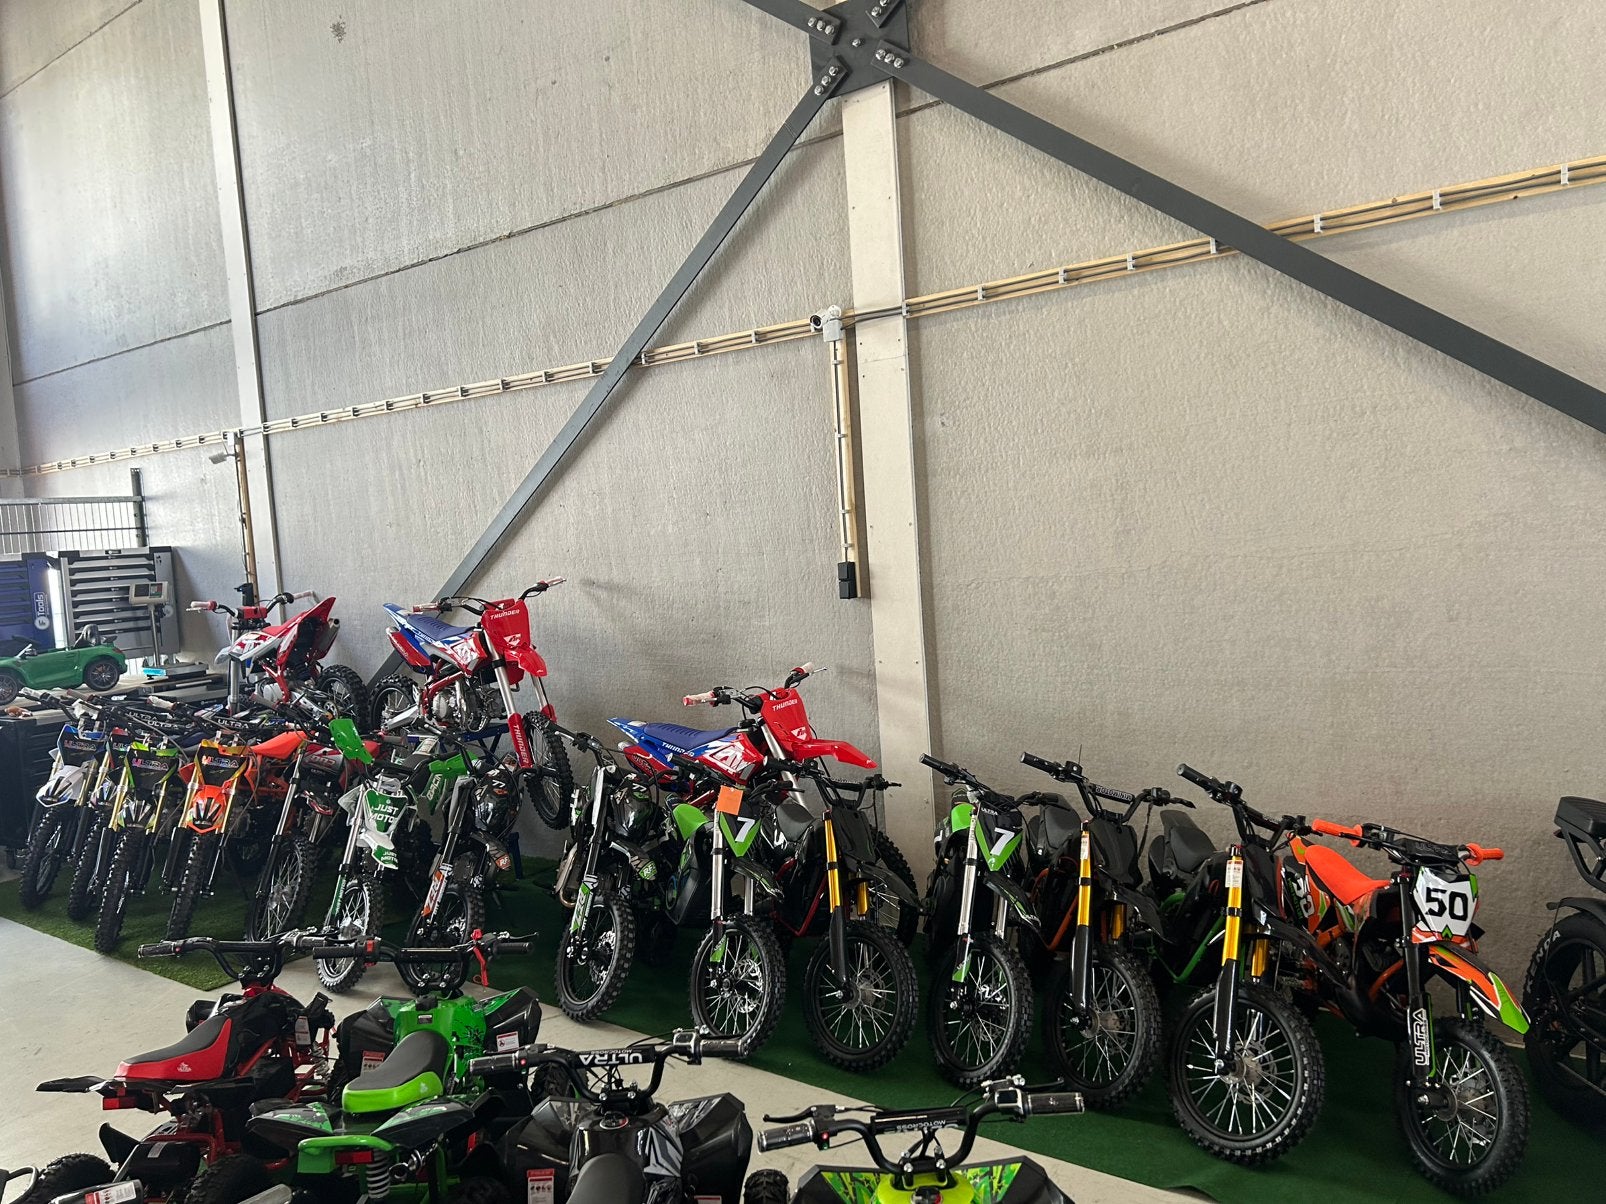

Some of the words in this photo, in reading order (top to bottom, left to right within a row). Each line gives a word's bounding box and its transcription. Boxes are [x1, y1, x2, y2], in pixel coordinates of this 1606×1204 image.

[35, 594, 45, 616] Tools
[490, 609, 520, 620] THUNDER
[772, 698, 798, 711] THUNDER
[128, 711, 158, 720] ULTRA
[147, 720, 179, 729] ULTRA
[217, 719, 249, 729] ULTRA
[513, 724, 529, 764] THUNDER
[132, 758, 169, 770] ULTRA
[201, 755, 239, 768] ULTRA
[374, 803, 398, 815] JUST
[981, 807, 998, 816] ULTRA
[735, 816, 755, 842] 7
[990, 827, 1015, 856] 7
[1425, 886, 1468, 922] 50
[1526, 930, 1560, 994] KENDA
[1412, 1008, 1427, 1065] ULTRA
[579, 1052, 643, 1066] ULTRA
[896, 1120, 946, 1131] MOTOCROSS
